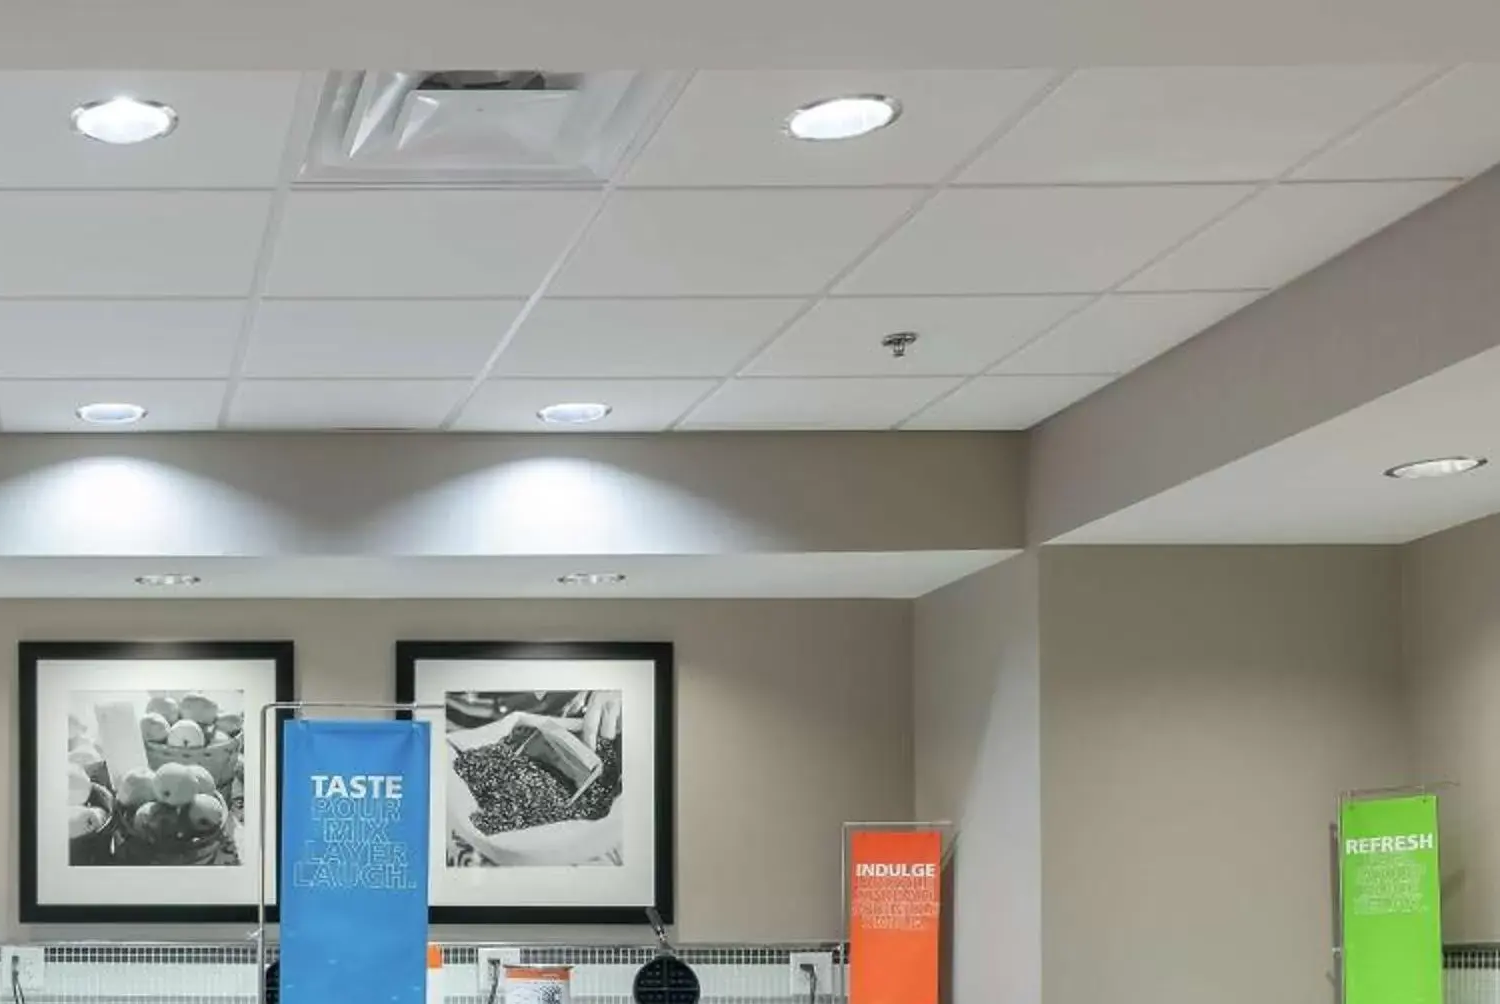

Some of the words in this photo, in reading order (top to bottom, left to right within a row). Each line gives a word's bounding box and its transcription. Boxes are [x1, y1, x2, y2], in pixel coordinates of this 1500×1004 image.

[310, 775, 403, 799] TASTE
[312, 799, 401, 820] POUR
[323, 819, 390, 842] MIX
[305, 841, 408, 866] LAYER
[1346, 832, 1433, 855] REFRESH
[294, 861, 417, 888] LAUGH.
[856, 863, 936, 877] INDULGE
